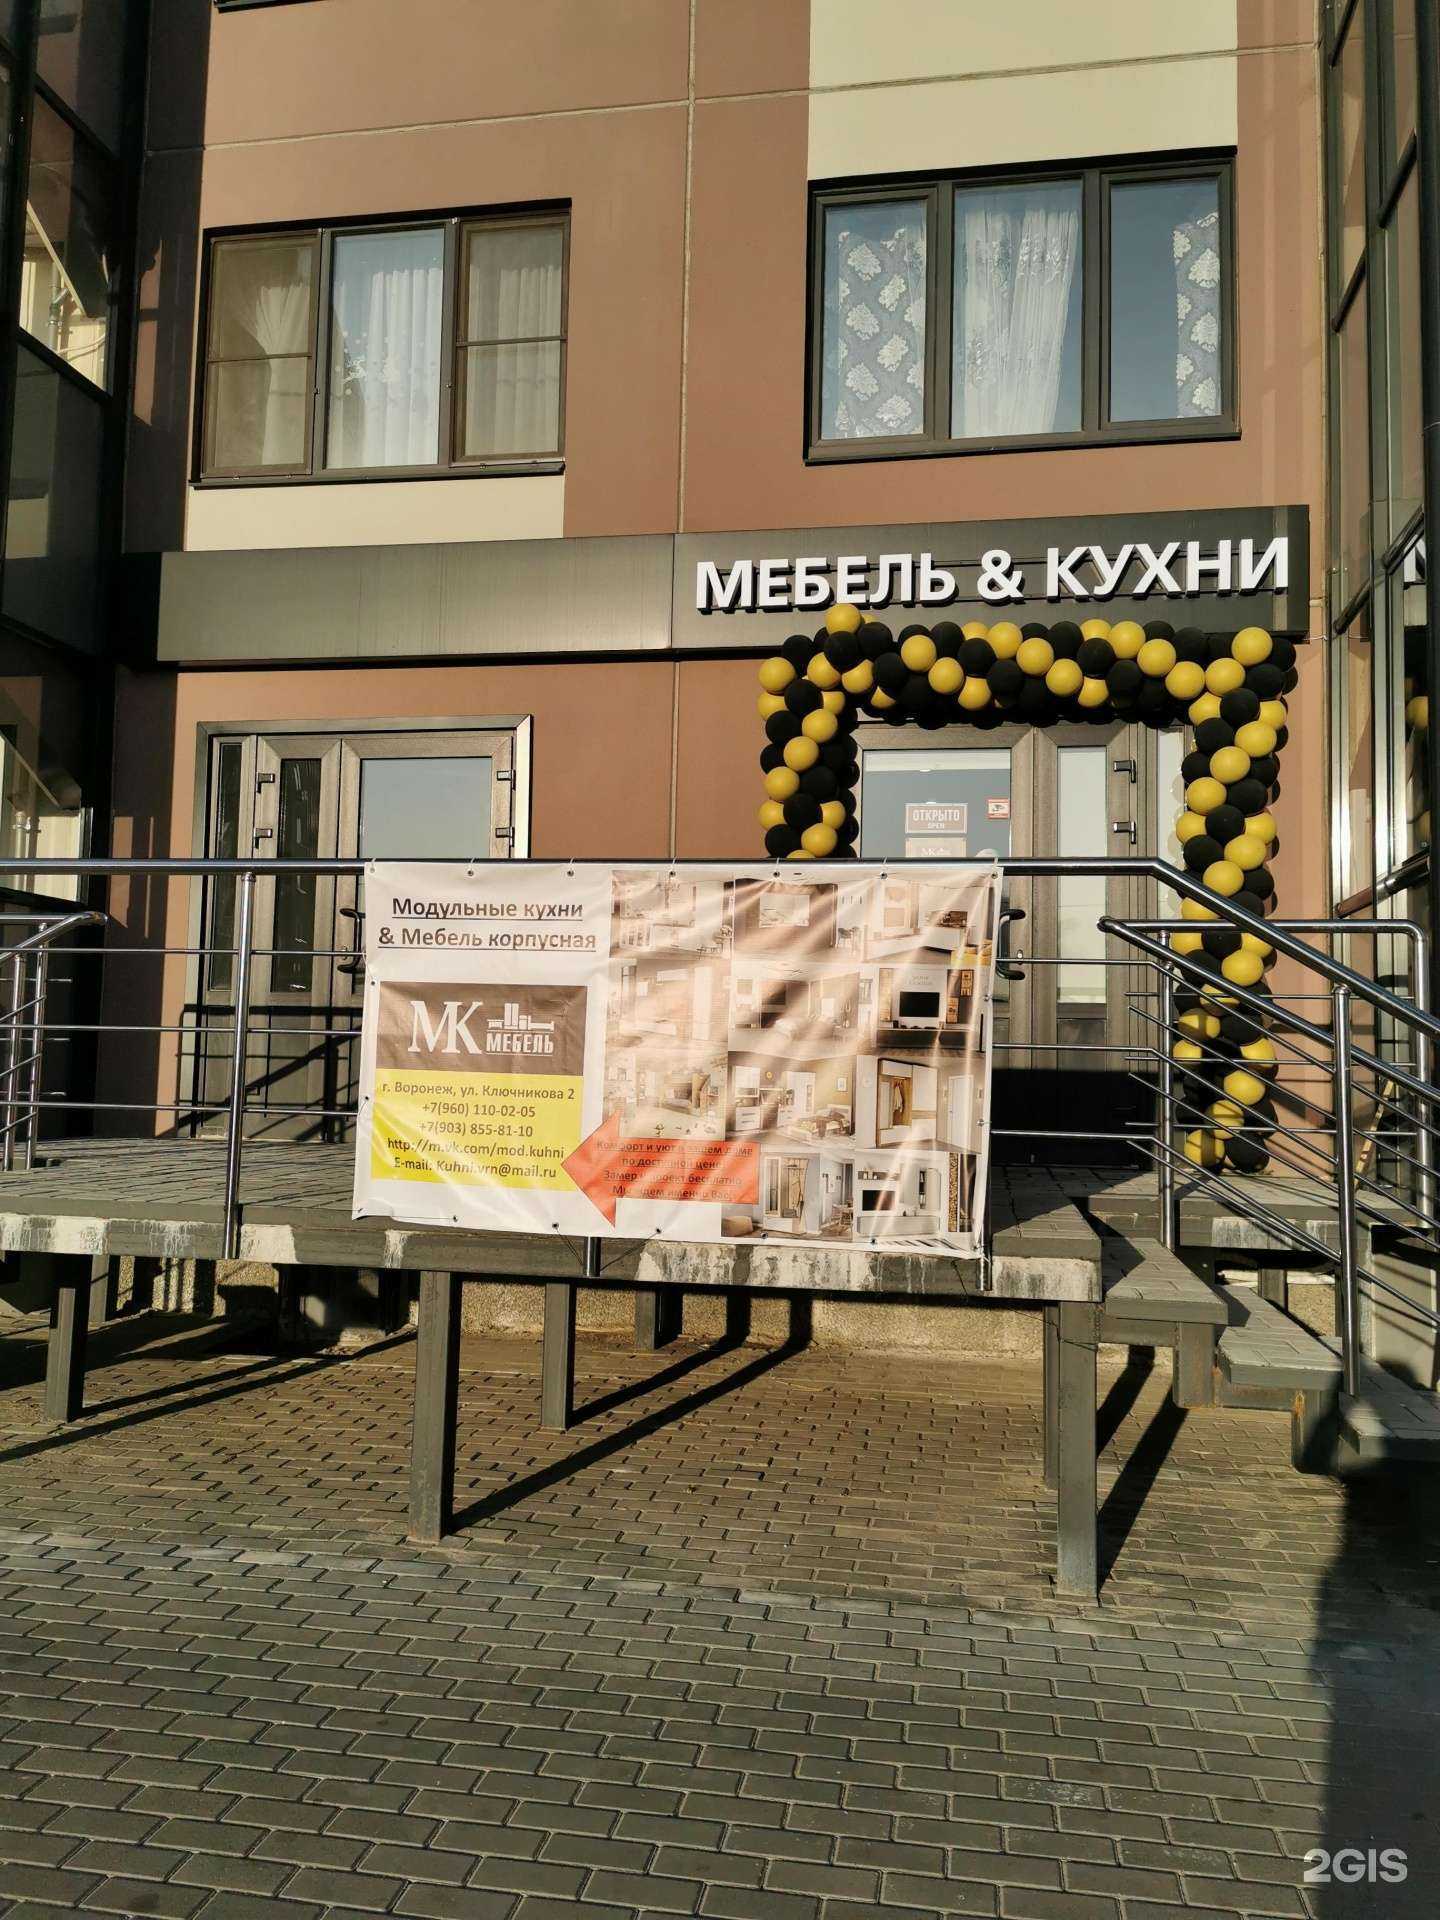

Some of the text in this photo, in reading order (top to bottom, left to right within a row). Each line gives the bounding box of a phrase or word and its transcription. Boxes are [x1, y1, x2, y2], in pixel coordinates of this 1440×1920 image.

[696, 536, 1290, 612] МЕБЕЛЬ & КУХНИ
[912, 809, 960, 822] ОТКРЫТО
[392, 898, 583, 921] Модульные кухни
[378, 926, 596, 950] & Мебель корпусная
[486, 1033, 555, 1054] МЕБЕЛЬ
[382, 1082, 575, 1100] г. Воронеж, ул. Ключникова 2
[422, 1102, 536, 1118] +7(960) 110-02-05
[418, 1122, 534, 1138] +7(903) 855-81-10
[603, 1170, 638, 1181] Замер
[688, 1172, 742, 1186] беслатно
